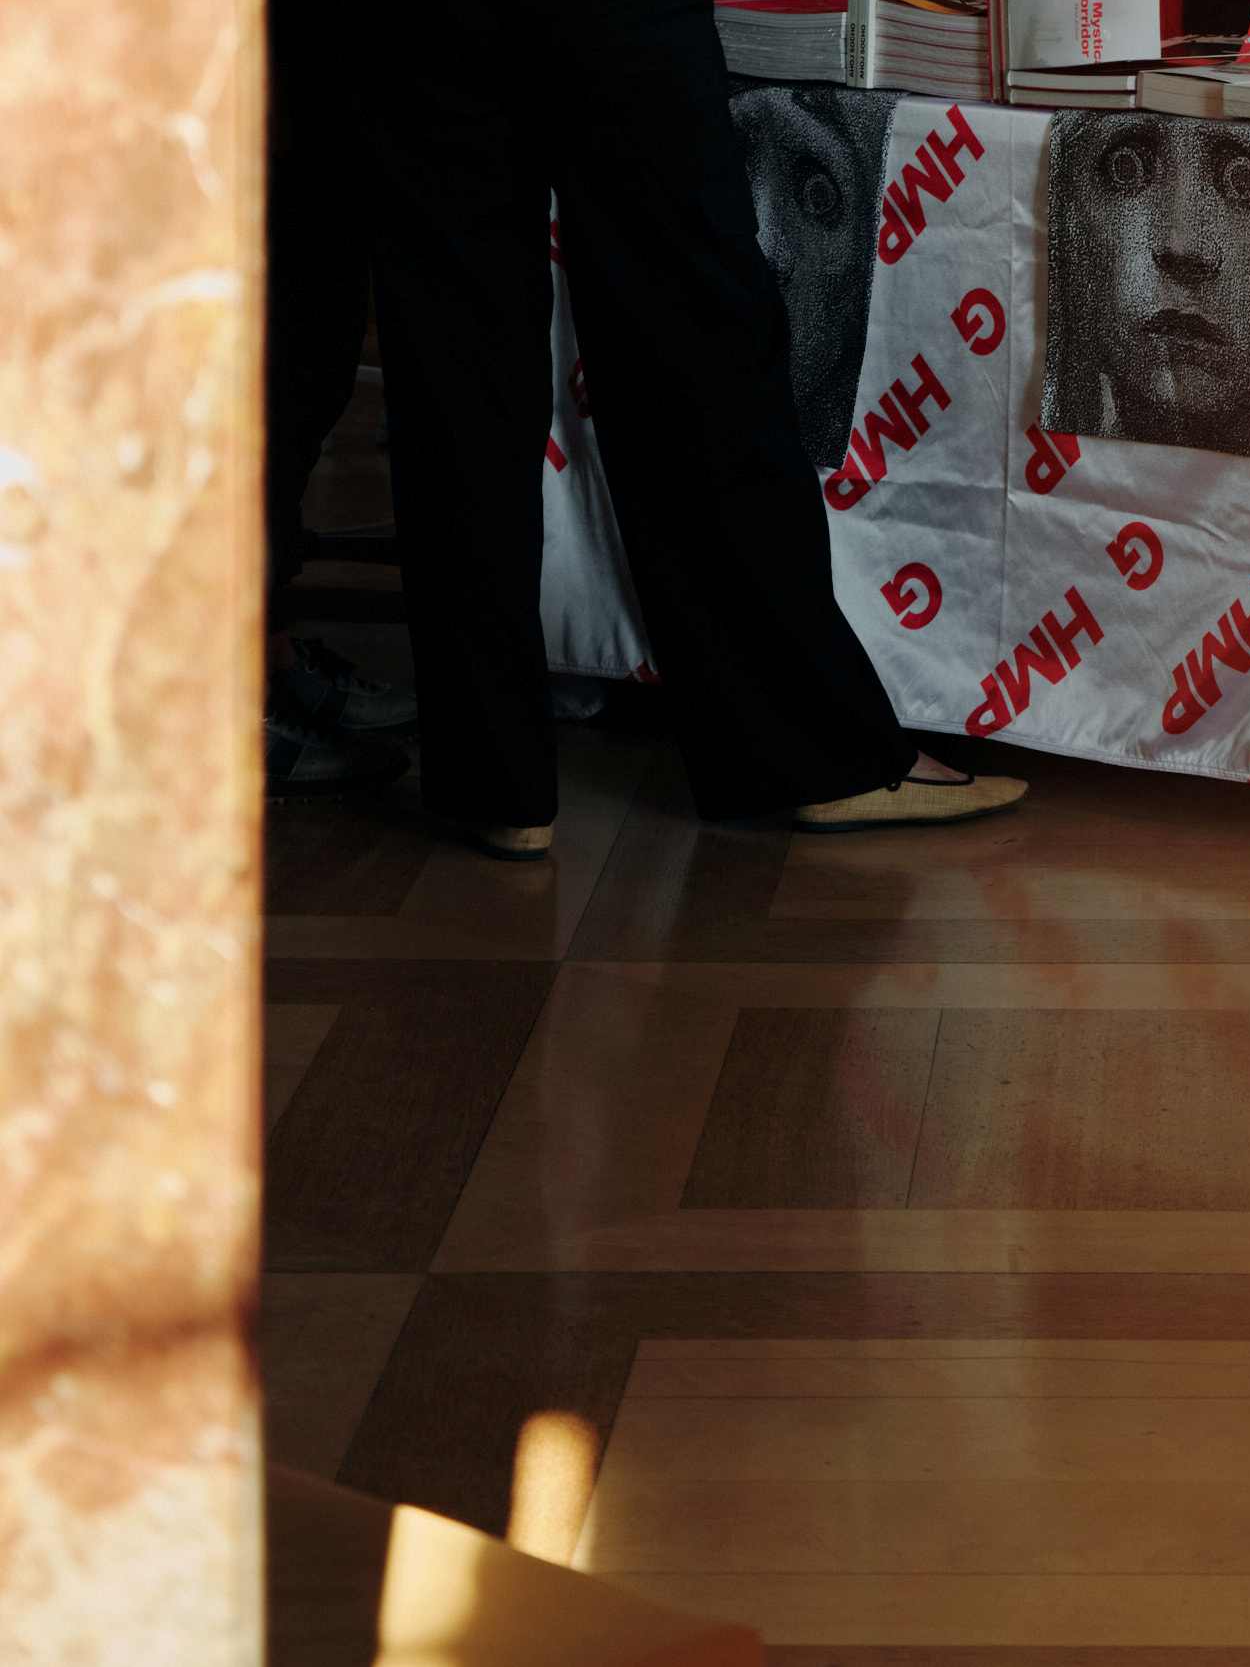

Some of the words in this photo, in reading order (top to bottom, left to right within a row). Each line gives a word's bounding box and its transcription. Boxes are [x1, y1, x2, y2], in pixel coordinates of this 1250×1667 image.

[1090, 1, 1104, 64] Mystic
[877, 103, 985, 265] HMP
[951, 287, 1006, 356] G
[823, 353, 952, 511] HMP
[1105, 521, 1164, 591] G
[880, 562, 943, 630] G
[964, 585, 1104, 738] HMP
